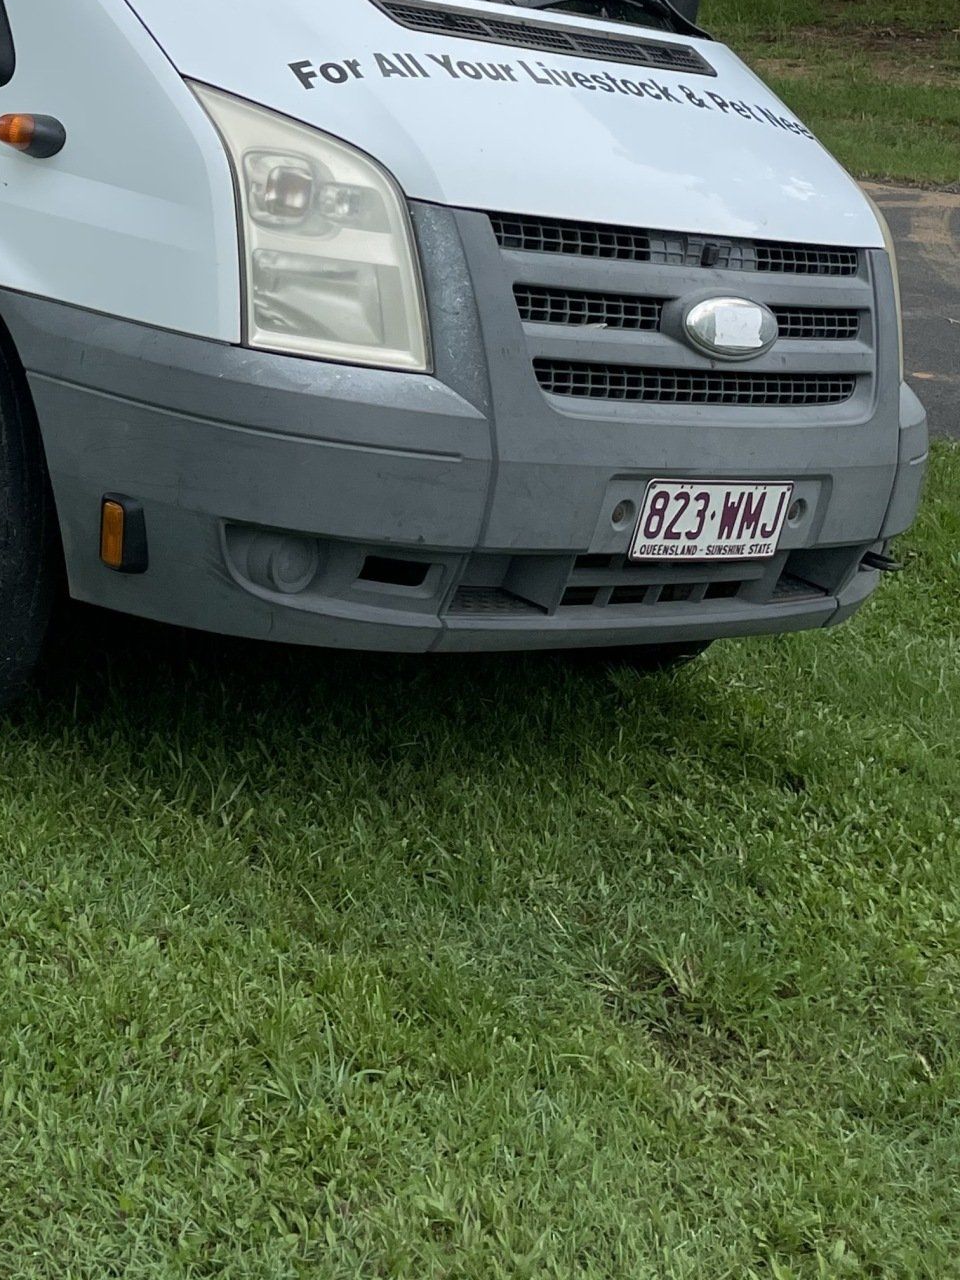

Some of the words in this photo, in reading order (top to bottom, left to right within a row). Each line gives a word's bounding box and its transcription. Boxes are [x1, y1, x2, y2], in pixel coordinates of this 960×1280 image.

[287, 57, 362, 90] For
[375, 53, 430, 78] All
[427, 54, 518, 82] Your
[517, 60, 684, 104] Livestock
[678, 84, 712, 110] &
[704, 90, 764, 123] Pet
[640, 544, 697, 556] QUEENSLAND
[705, 544, 745, 556] SUNSHINE
